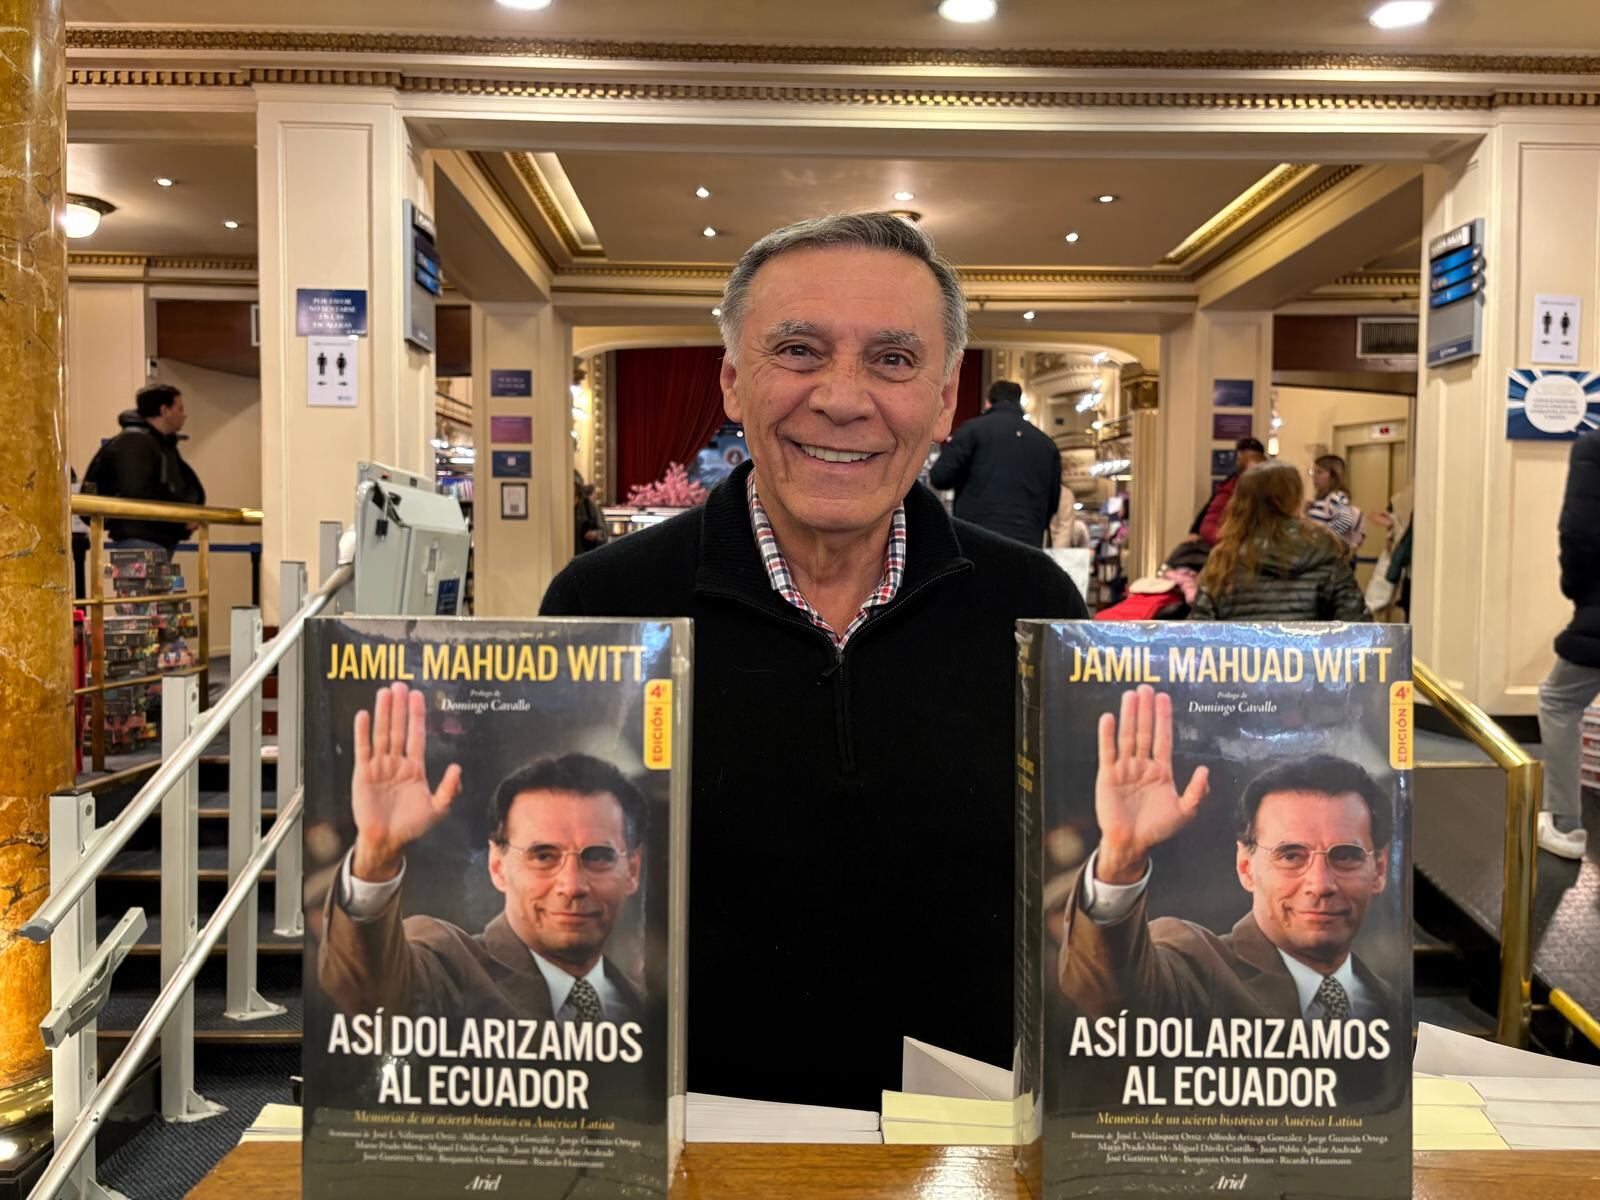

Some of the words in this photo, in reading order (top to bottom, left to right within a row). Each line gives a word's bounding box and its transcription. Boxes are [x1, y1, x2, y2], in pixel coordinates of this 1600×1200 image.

[327, 643, 415, 681] JAMIL
[422, 644, 559, 682] MAHUAD
[567, 645, 647, 683] WITT
[1069, 645, 1161, 683] JAMIL
[1168, 646, 1304, 683] MAHUAD
[1312, 646, 1393, 684] WITT
[1240, 691, 1248, 699] de
[441, 698, 489, 714] Domingo
[490, 698, 531, 712] Cavallo
[1188, 700, 1236, 716] Domingo
[1238, 700, 1278, 713] Cavallo
[651, 706, 663, 762] EDICIÓN
[1396, 708, 1408, 763] EDICIÓN
[328, 1007, 385, 1056] ASÍ
[391, 1015, 644, 1063] DOLARIZAMOS
[1069, 1009, 1129, 1057] ASÍ
[1136, 1017, 1391, 1060] DOLARIZAMOS
[378, 1062, 422, 1105] AL
[428, 1065, 590, 1110] ECUADOR
[1122, 1065, 1167, 1106] AL
[1174, 1066, 1338, 1107] ECUADOR
[354, 1109, 404, 1123] Memorias
[407, 1111, 418, 1124] de
[421, 1115, 435, 1124] un
[518, 1118, 531, 1128] en
[535, 1116, 578, 1130] América
[580, 1117, 616, 1131] Latina
[1096, 1111, 1150, 1125] Memorias
[1151, 1112, 1164, 1125] de
[1166, 1116, 1180, 1125] un
[1182, 1114, 1218, 1126] acierto
[1219, 1113, 1263, 1127] histórico
[1265, 1118, 1278, 1127] en
[1280, 1114, 1325, 1128] América
[1328, 1114, 1364, 1128] Latina
[1207, 1132, 1236, 1141] Alfredo
[1307, 1133, 1327, 1144] Jorge
[1361, 1134, 1388, 1144] Ortega
[1172, 1143, 1199, 1153] Miguel
[1260, 1144, 1277, 1155] Juan
[1279, 1144, 1300, 1153] Pablo
[1330, 1145, 1362, 1154] Andrade
[1280, 1156, 1309, 1165] Ricardo
[464, 1173, 502, 1191] Ariel
[1210, 1172, 1248, 1191] Ariel
